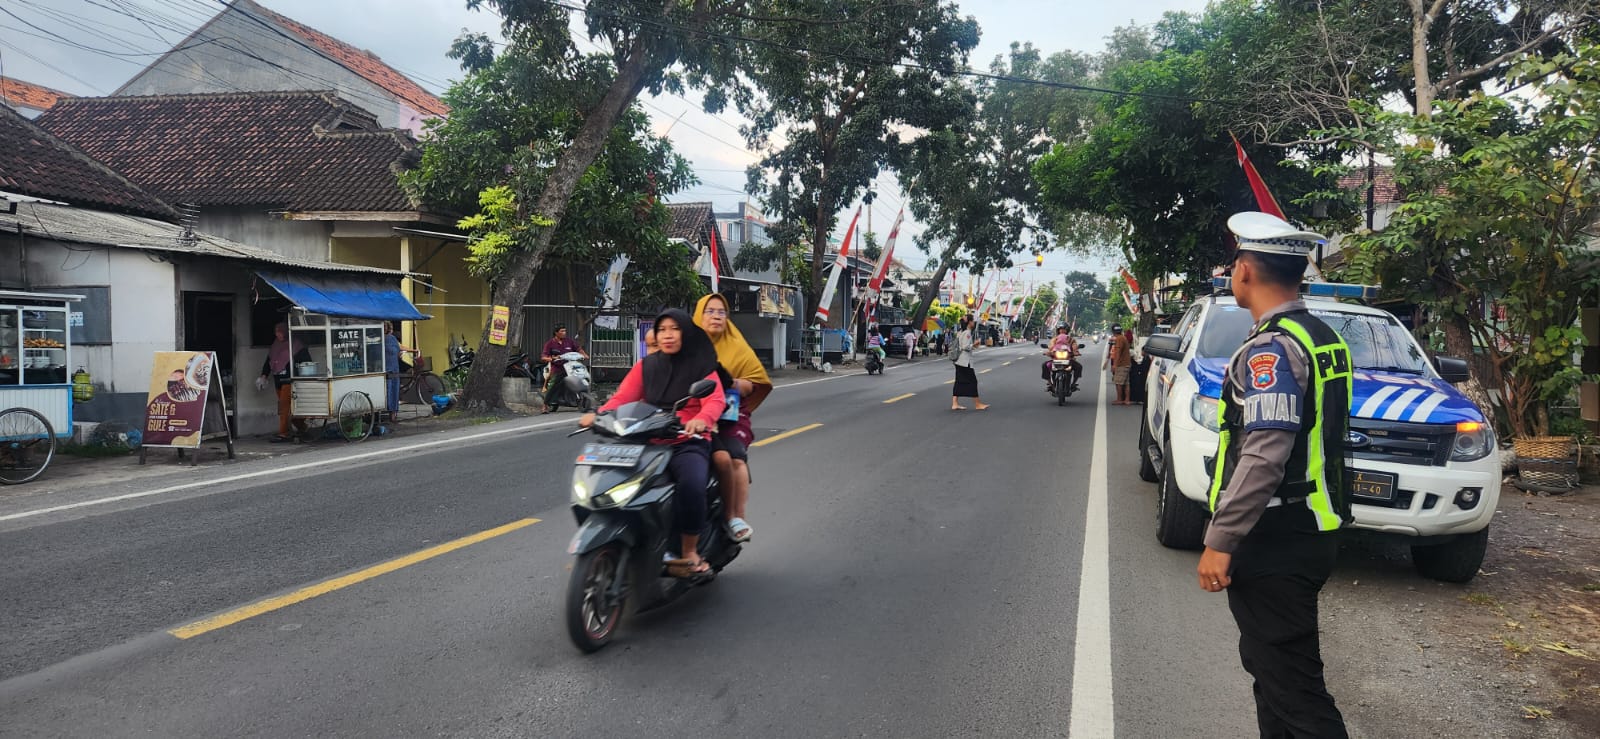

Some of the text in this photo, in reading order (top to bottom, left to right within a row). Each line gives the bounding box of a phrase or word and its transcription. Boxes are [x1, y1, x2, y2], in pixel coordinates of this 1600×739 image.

[338, 330, 359, 339] SATE
[150, 403, 168, 415] SATE
[148, 420, 166, 432] GULE
